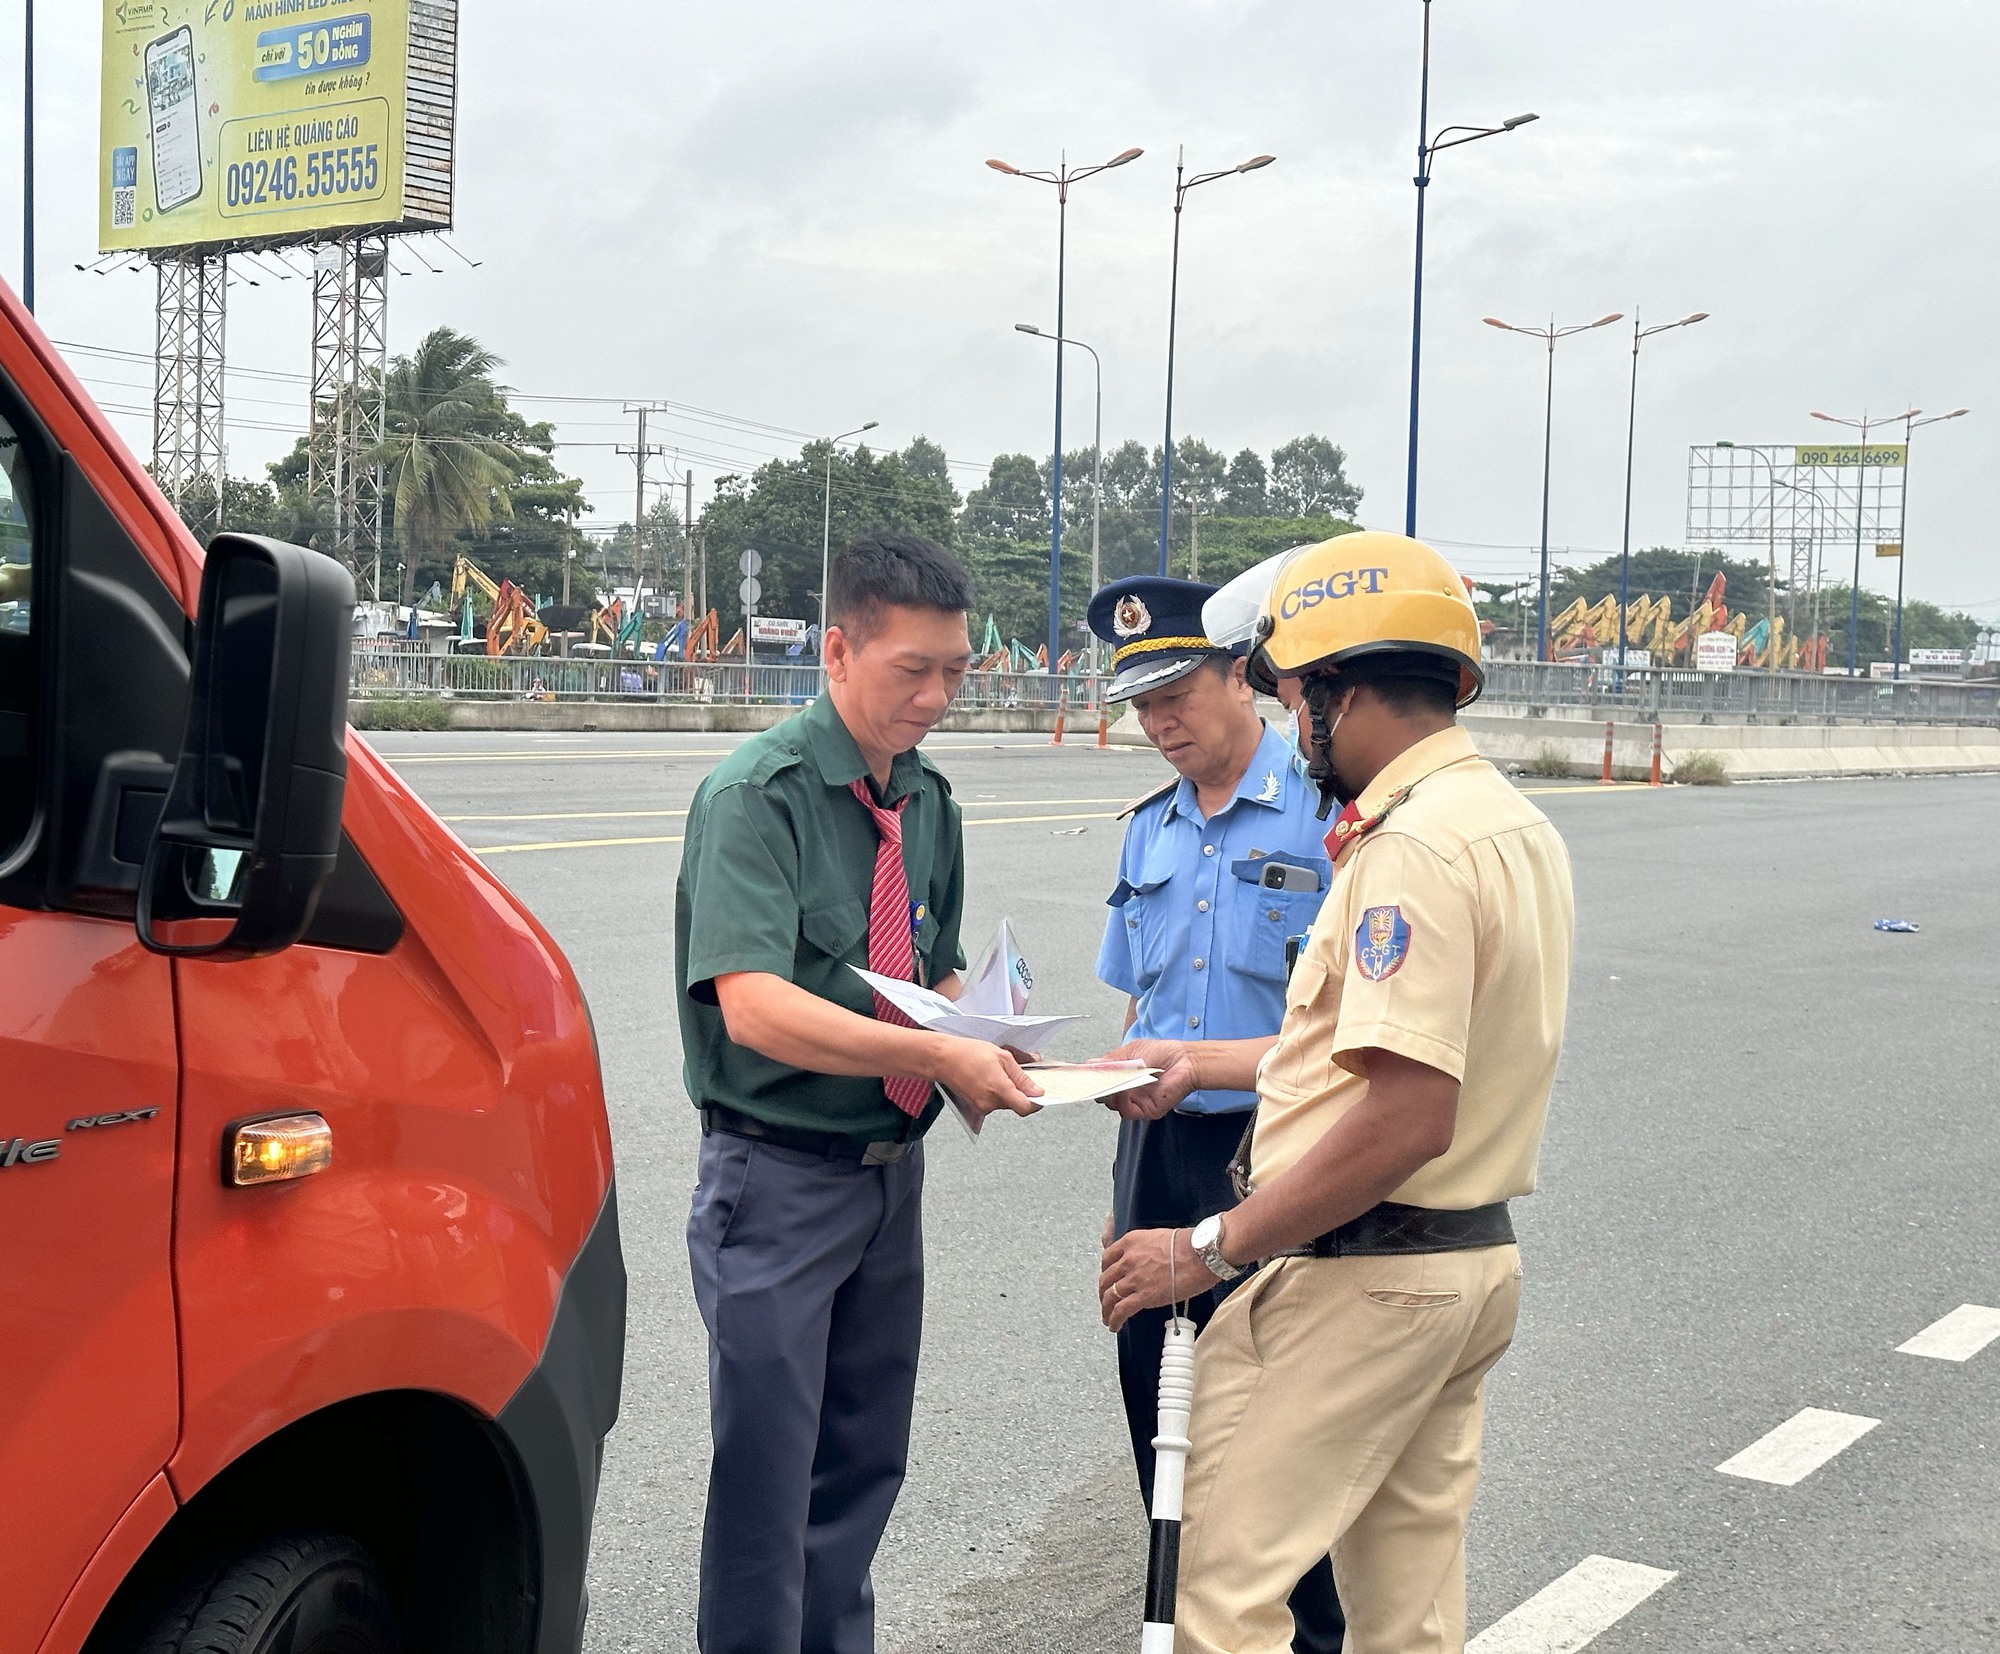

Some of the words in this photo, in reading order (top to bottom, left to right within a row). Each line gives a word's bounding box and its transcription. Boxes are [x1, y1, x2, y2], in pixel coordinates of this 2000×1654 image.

[332, 20, 363, 40] NGHÌN
[297, 28, 330, 69] 50
[317, 80, 337, 97] được
[338, 74, 363, 91] không
[248, 127, 273, 153] LIÊN
[276, 123, 291, 152] HỆ
[294, 118, 333, 147] QUẢNG
[336, 114, 359, 140] CÁO
[226, 144, 378, 207] 09246.55555
[1802, 452, 1829, 465] 090
[1832, 451, 1860, 464] 464
[1864, 451, 1900, 464] 6699
[1280, 567, 1389, 620] CSGT
[65, 1105, 162, 1131] NEXT
